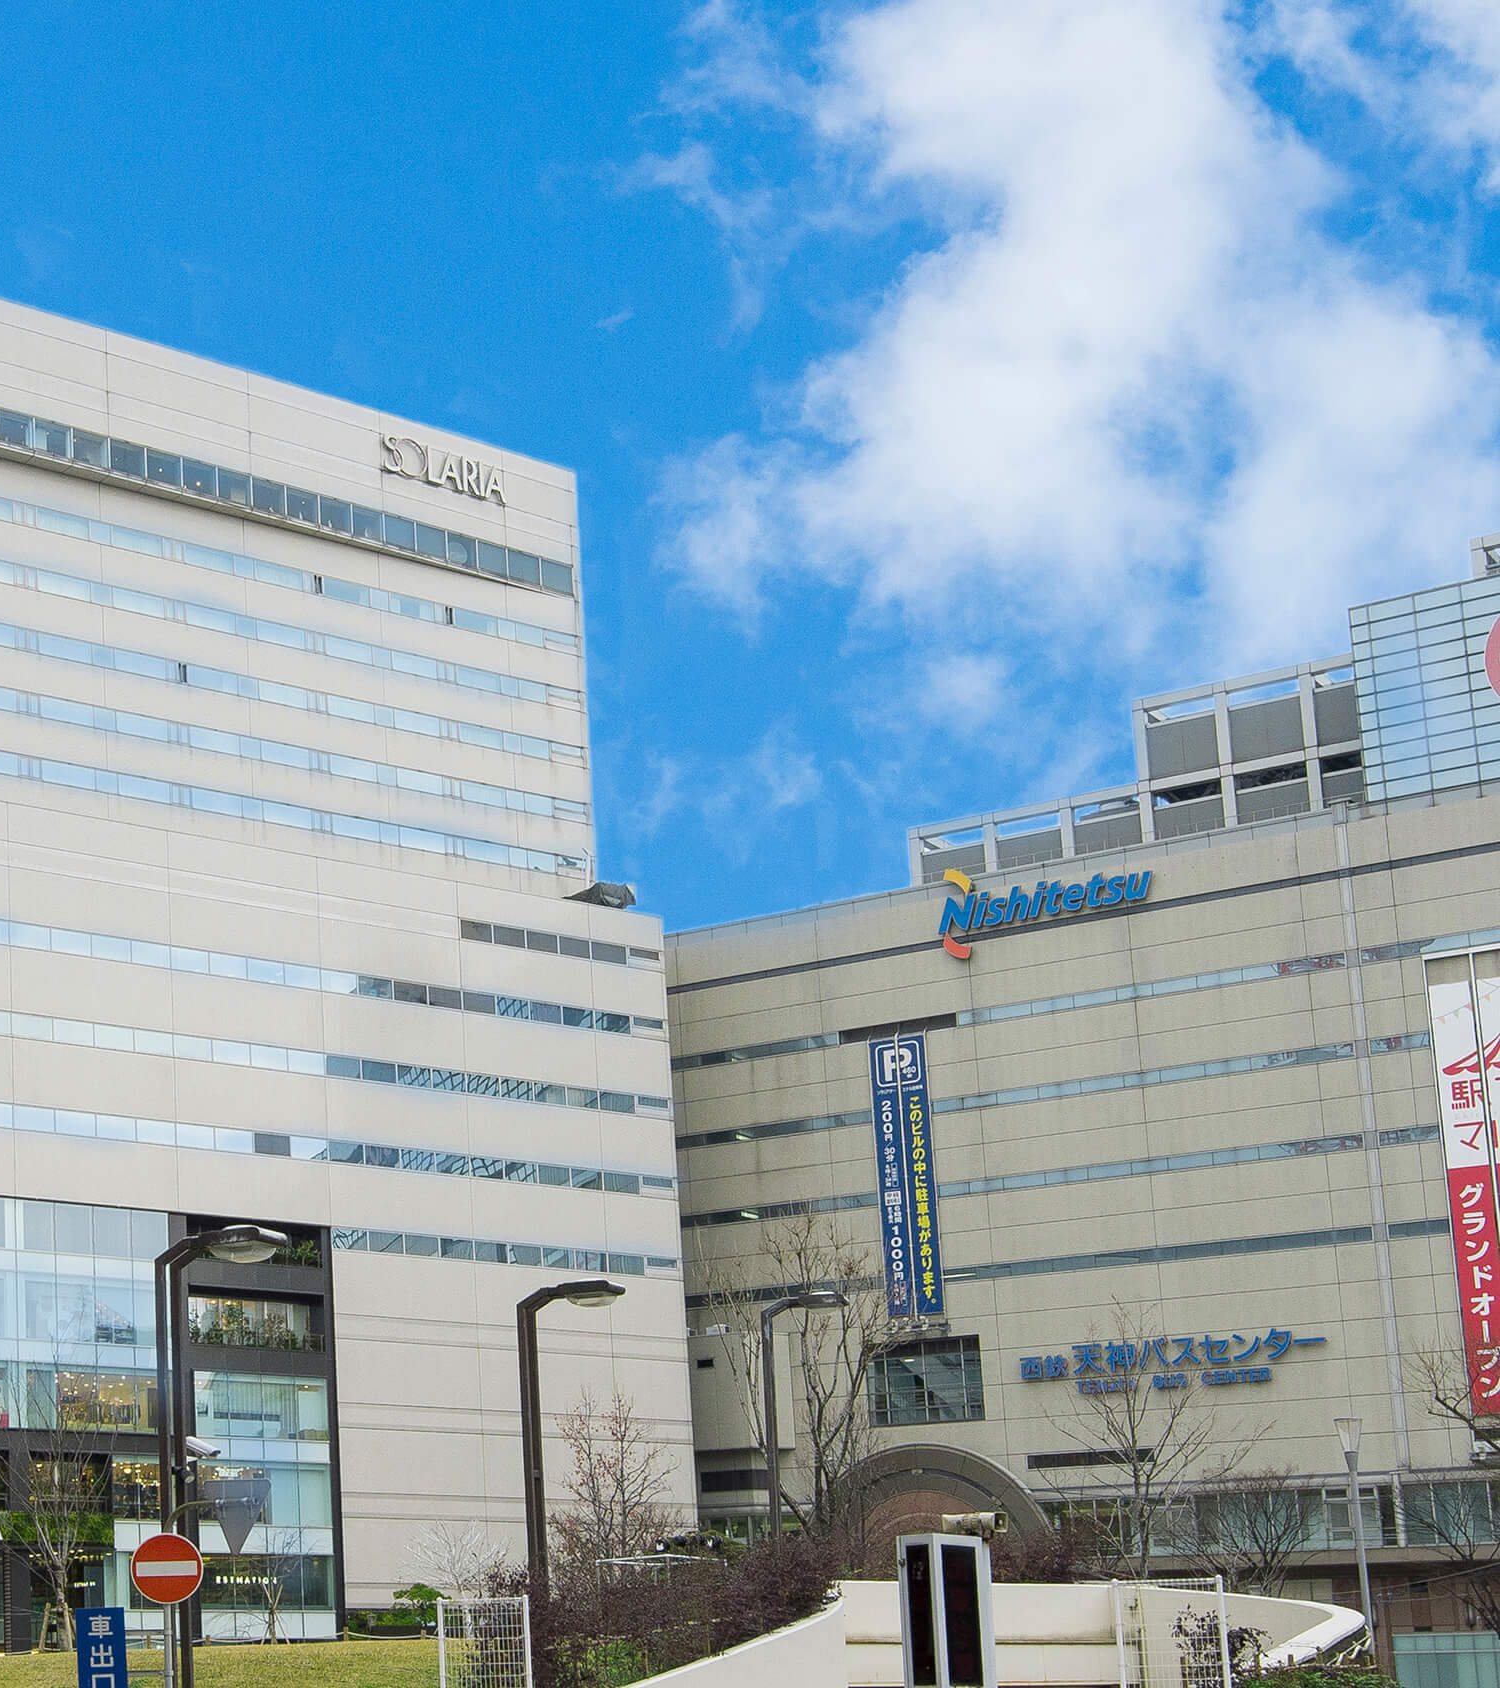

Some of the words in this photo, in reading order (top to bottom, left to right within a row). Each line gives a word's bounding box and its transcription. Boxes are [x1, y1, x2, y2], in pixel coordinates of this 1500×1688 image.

[381, 436, 506, 505] SOLARIA
[938, 870, 1153, 935] Nishitetsu
[882, 1047, 913, 1082] P
[909, 1095, 937, 1304] このビルの中に駐車場があります。
[1459, 1182, 1500, 1398] グランドオープン
[1071, 1328, 1327, 1376] 天神バスセンター
[1153, 1372, 1188, 1389] BUS
[1201, 1367, 1272, 1385] CENTER
